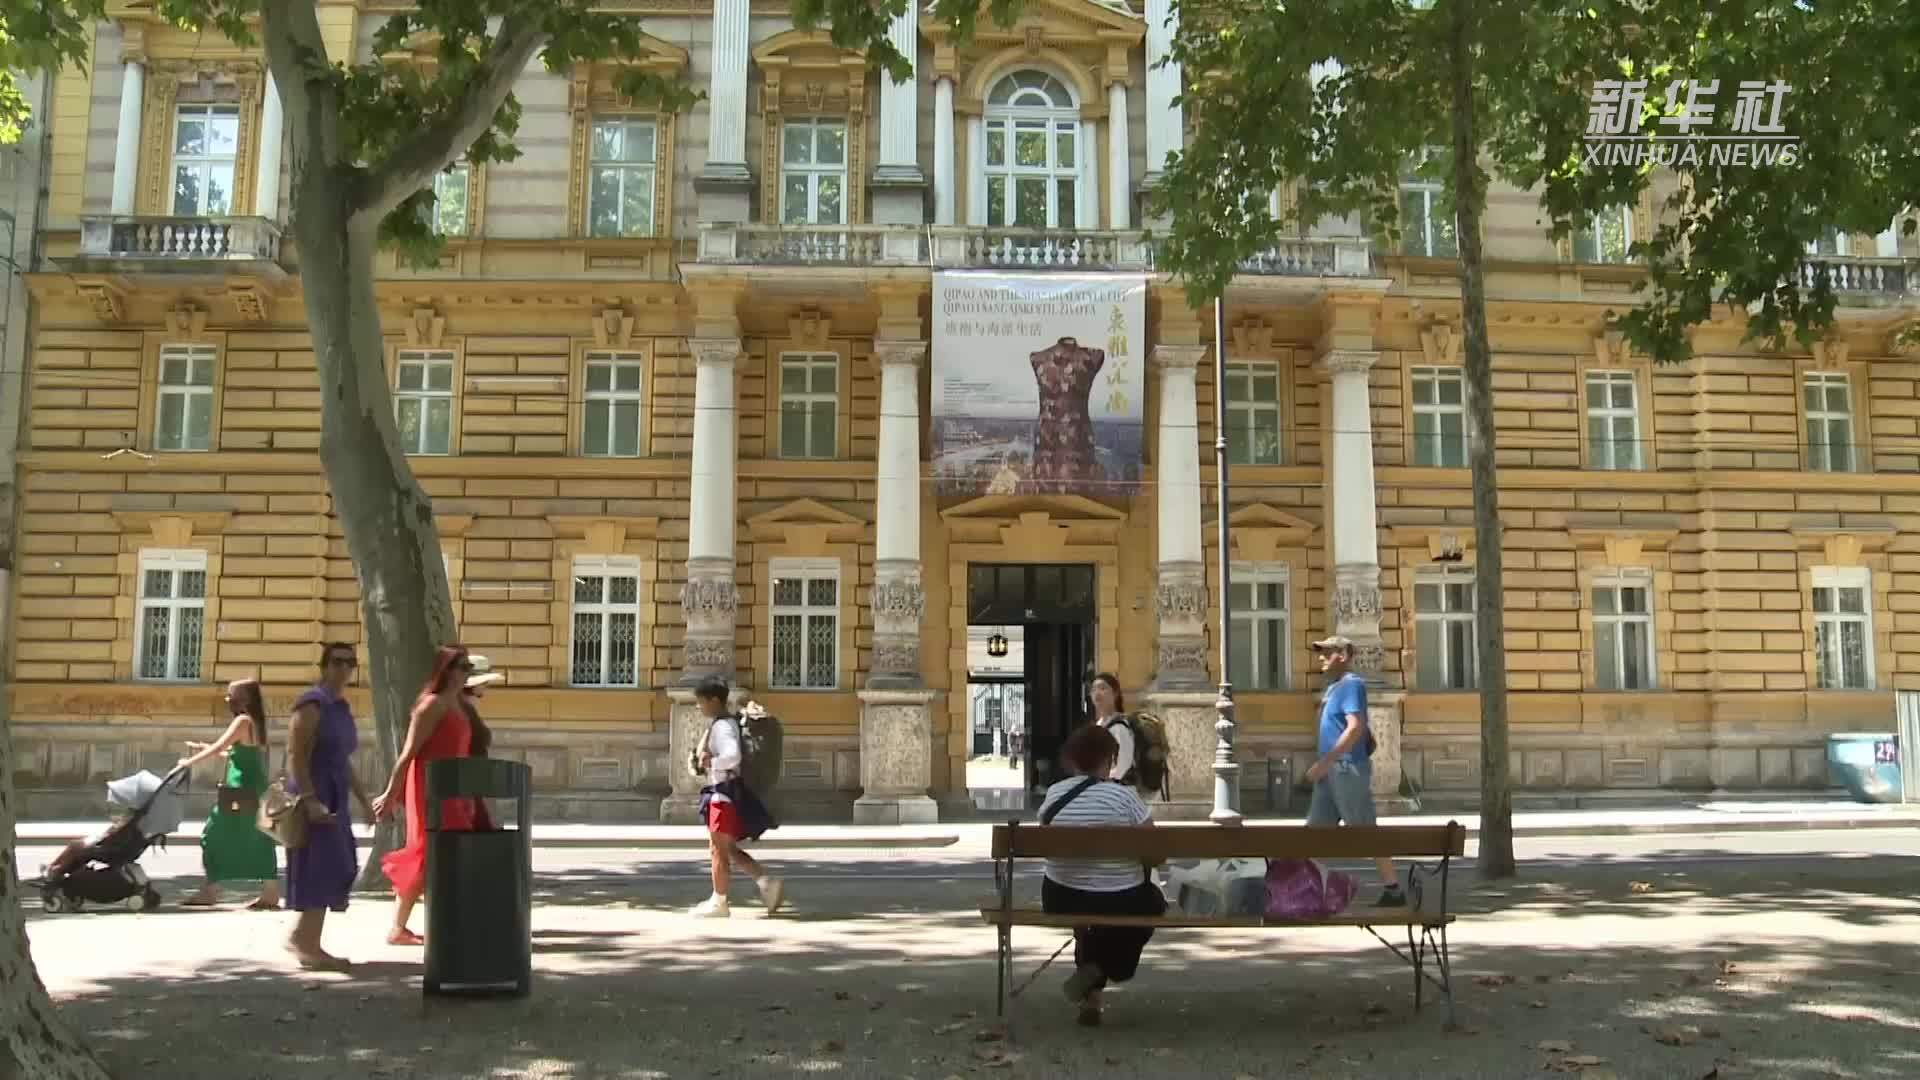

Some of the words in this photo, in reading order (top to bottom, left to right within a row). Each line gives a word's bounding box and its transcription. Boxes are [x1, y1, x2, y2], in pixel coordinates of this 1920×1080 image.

[944, 288, 975, 302] QIPAO
[977, 288, 998, 301] AND
[1000, 288, 1020, 301] THE
[944, 303, 974, 316] QIPAO
